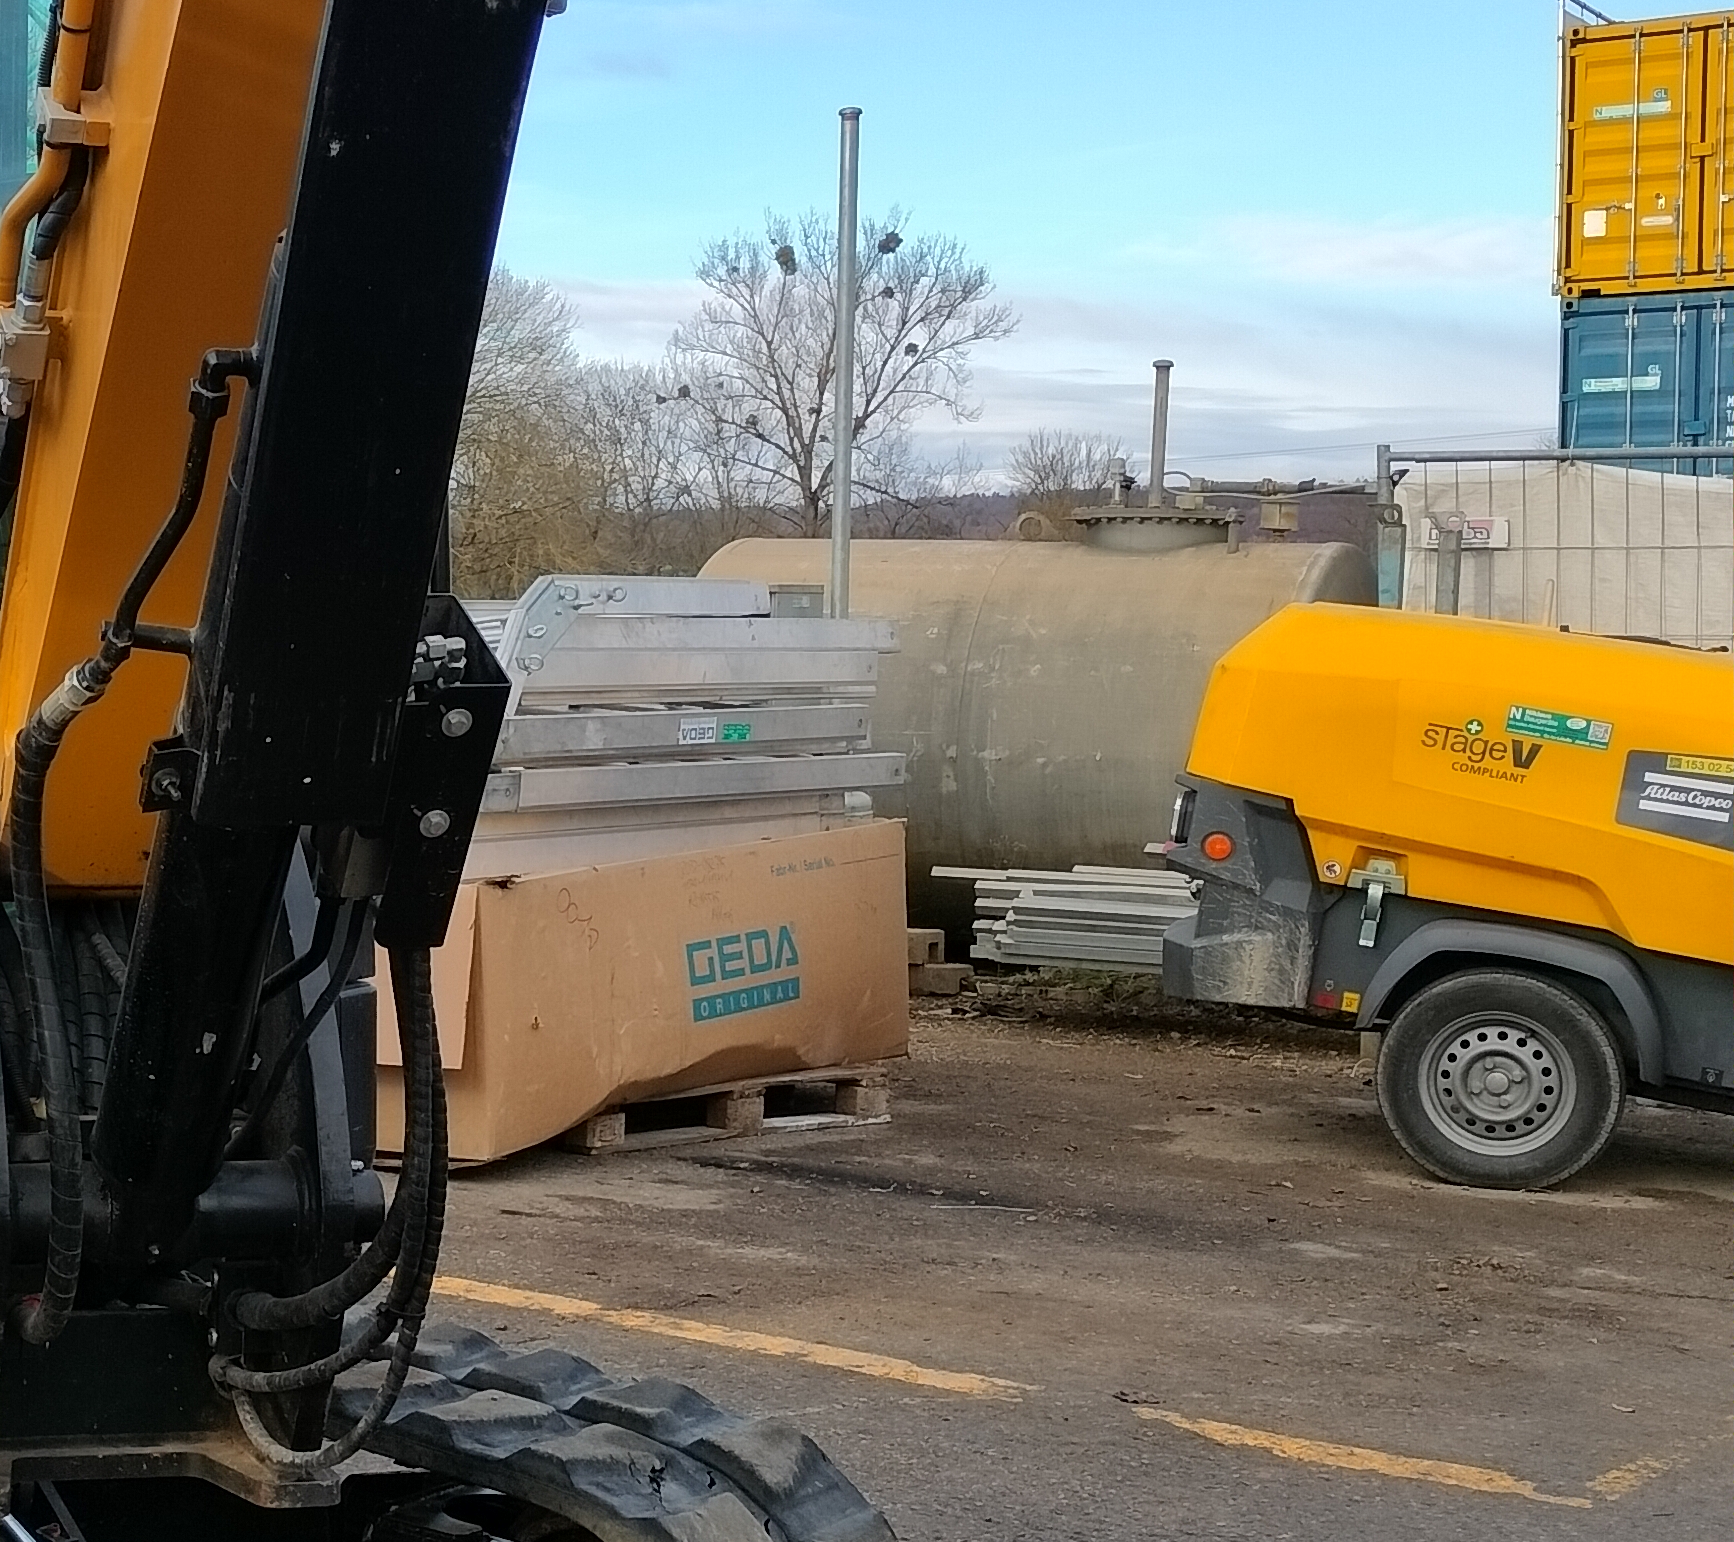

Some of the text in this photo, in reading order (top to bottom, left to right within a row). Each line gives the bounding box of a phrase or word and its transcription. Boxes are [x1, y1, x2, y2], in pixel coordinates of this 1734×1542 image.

[1451, 761, 1527, 784] COMPLIANT
[1685, 759, 1705, 771] 153
[1707, 761, 1722, 773] 02
[1640, 784, 1733, 809] Atlas Copco
[685, 924, 799, 987] GEDA
[700, 982, 795, 1018] ORIGINAL
